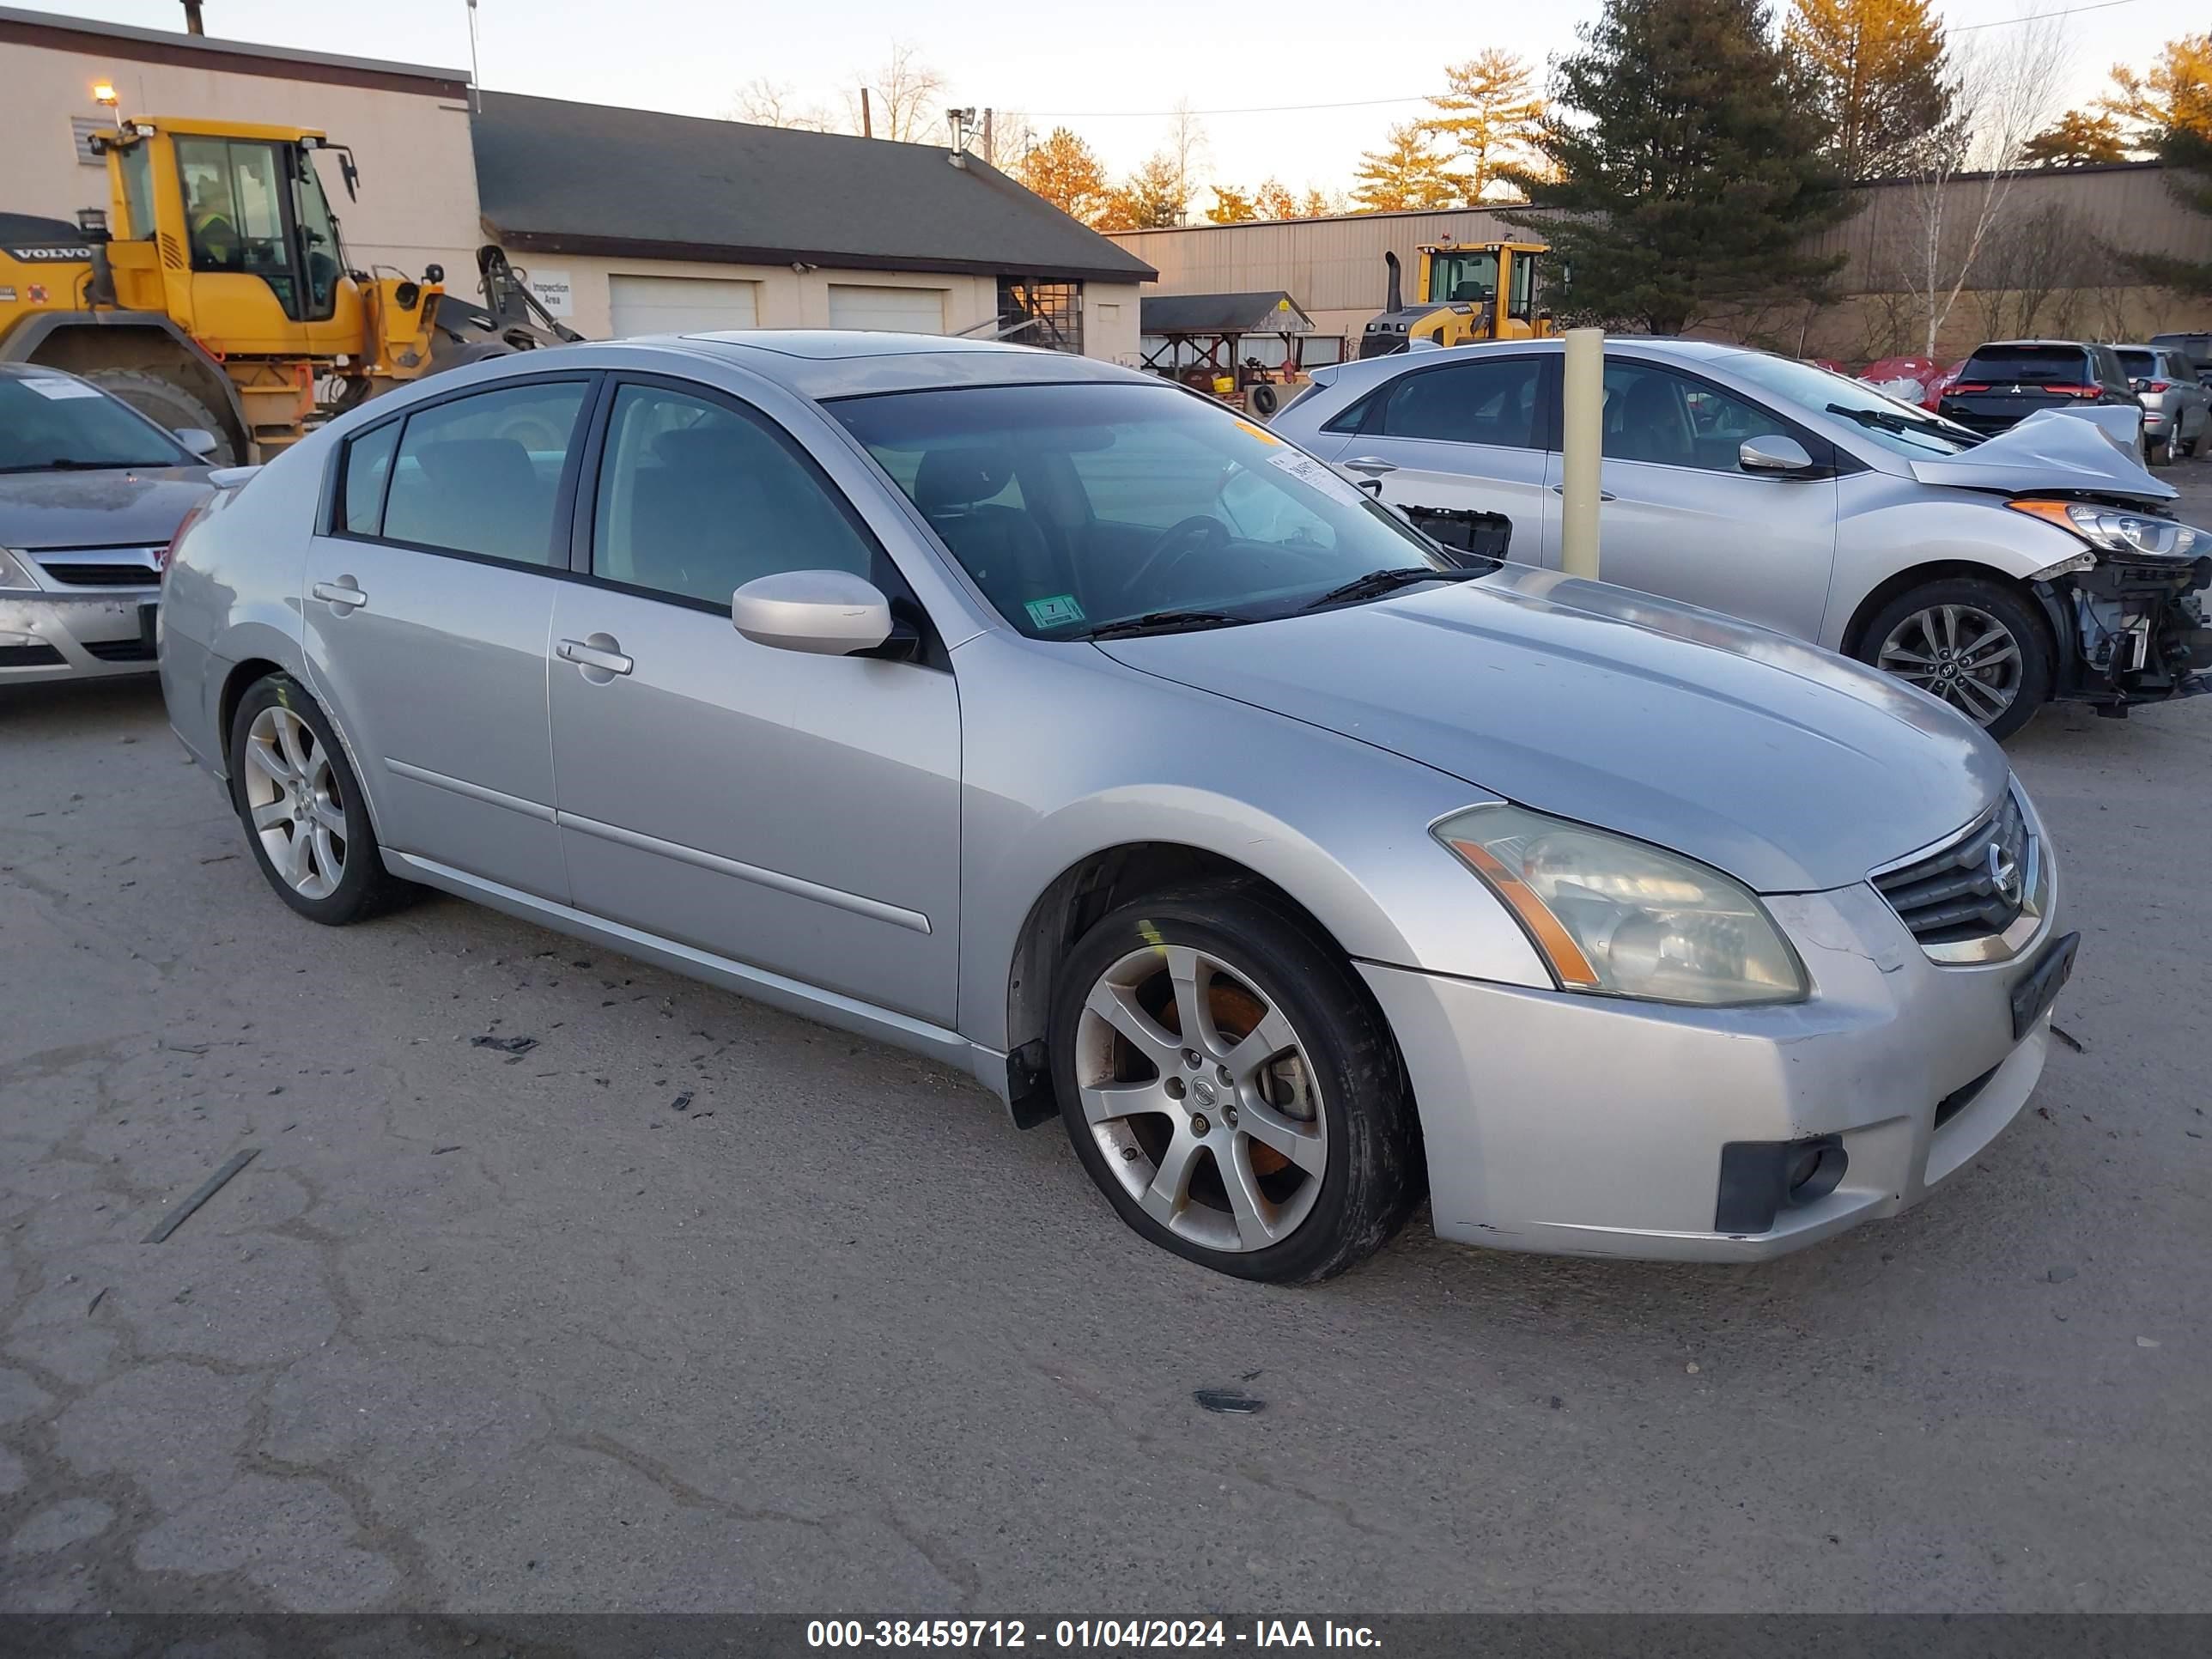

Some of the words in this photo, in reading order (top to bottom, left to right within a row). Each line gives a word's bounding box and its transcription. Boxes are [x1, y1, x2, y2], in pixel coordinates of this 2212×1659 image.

[14, 247, 92, 259] VOLVO
[532, 282, 569, 294] Inspection
[544, 295, 561, 305] Area
[1046, 604, 1055, 613] 7
